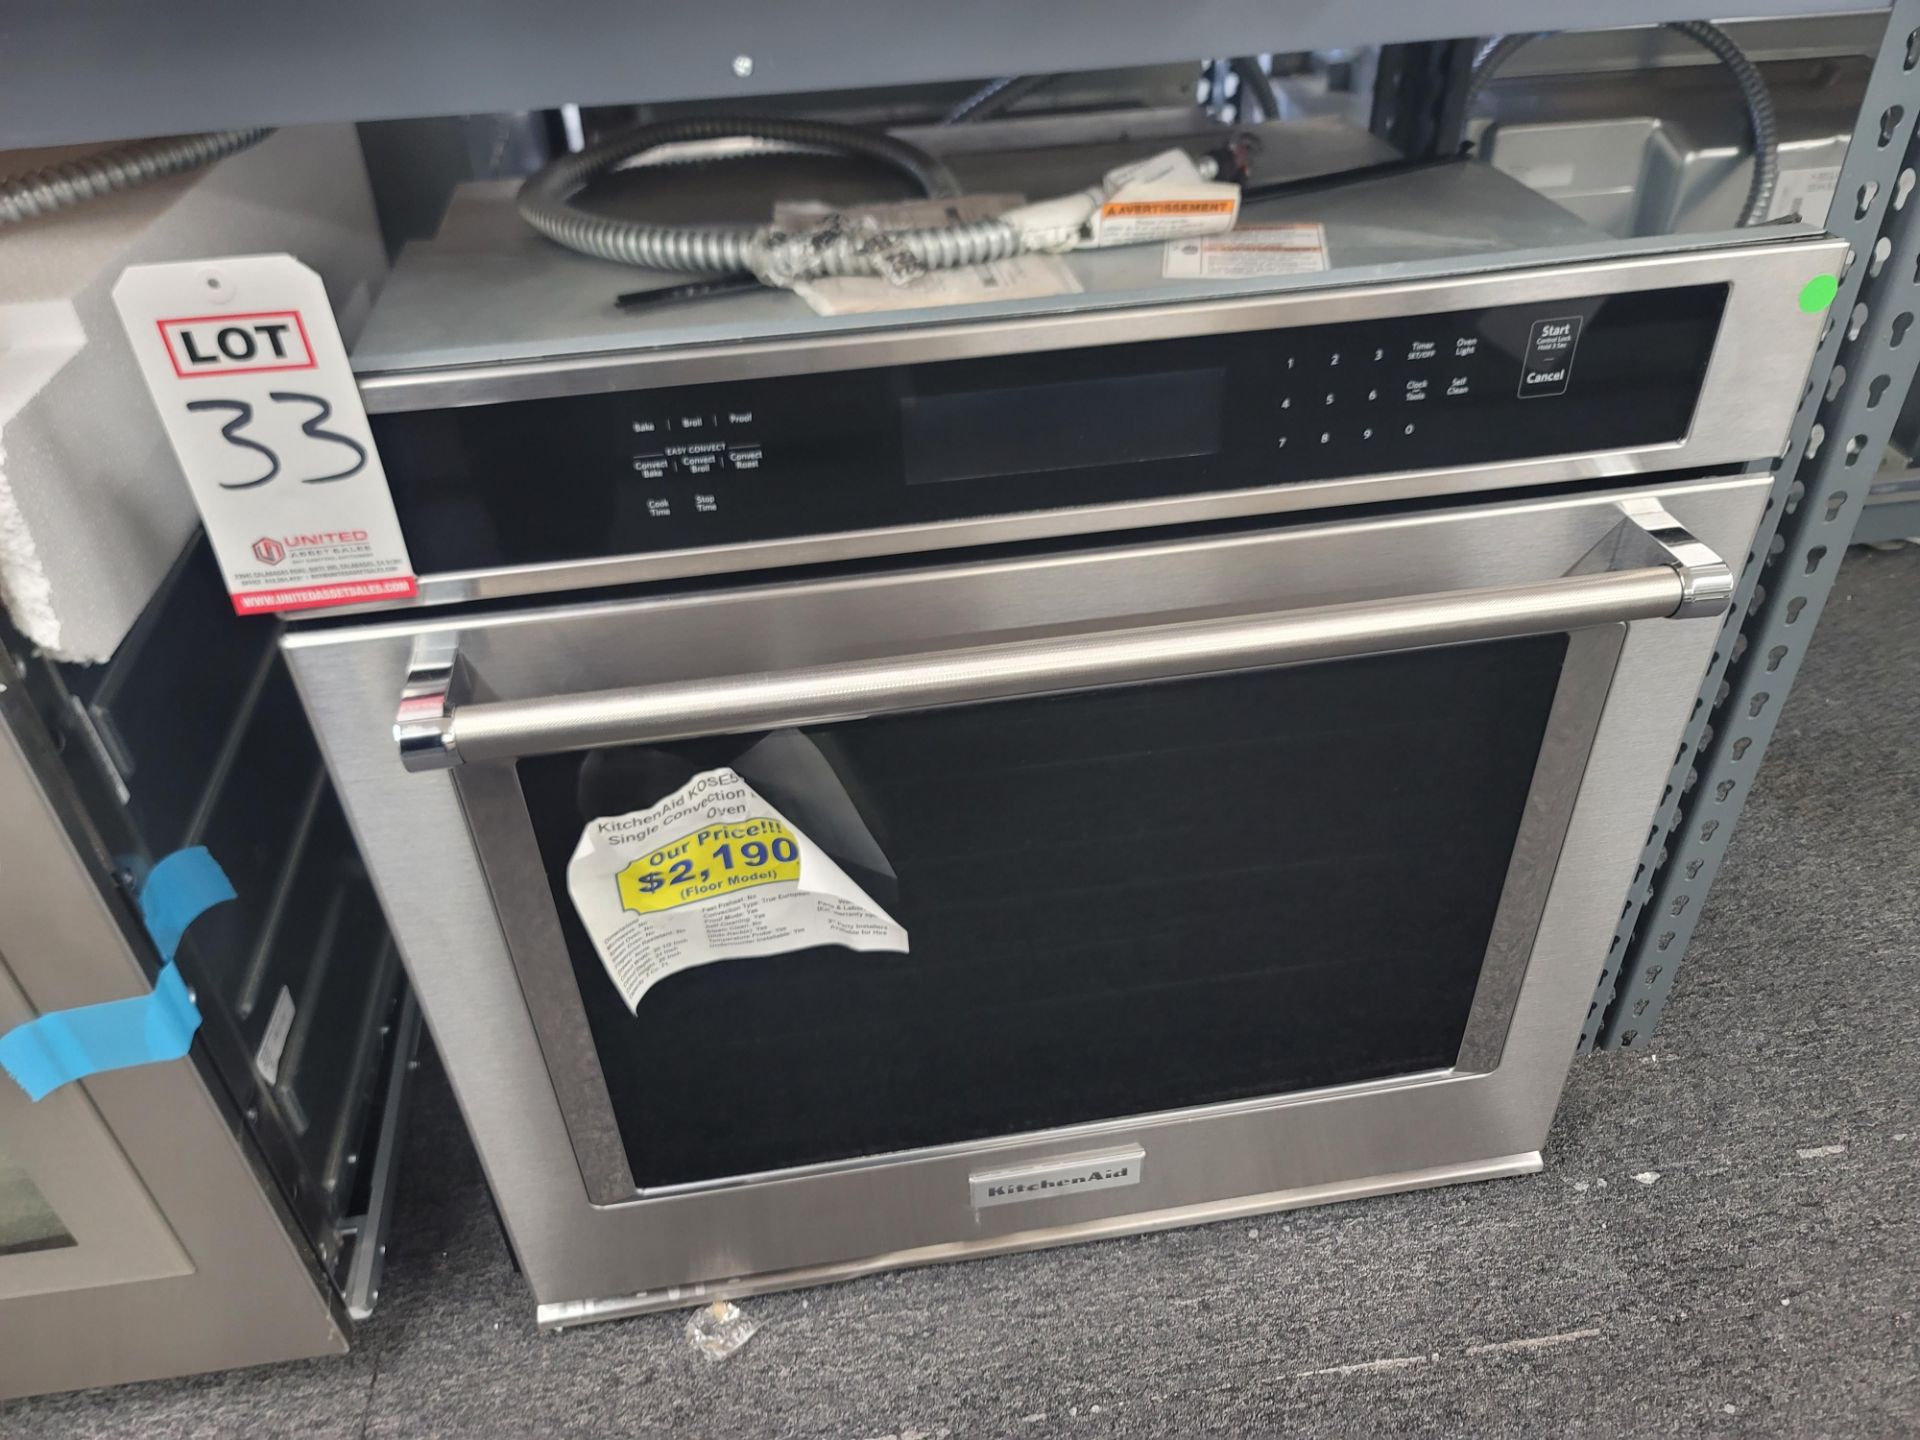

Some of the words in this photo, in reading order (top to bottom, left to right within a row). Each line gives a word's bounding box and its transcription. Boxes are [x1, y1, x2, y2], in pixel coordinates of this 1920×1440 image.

[1119, 202, 1229, 215] AVERTISSEMENT
[1542, 324, 1570, 337] Start
[179, 324, 289, 366] LOT
[1412, 342, 1435, 350] Timer
[1456, 338, 1478, 347] Oven
[1374, 350, 1383, 361] 3
[1407, 350, 1436, 360] SET/OFF
[1455, 346, 1475, 356] Light
[1287, 358, 1294, 369] 1
[1331, 354, 1340, 365] 2
[1451, 377, 1468, 386] Self
[1526, 369, 1565, 384] Cancel
[1406, 380, 1428, 389] Clock
[1369, 390, 1378, 400] 6
[1447, 387, 1469, 395] Clean
[1281, 398, 1290, 409] 4
[1325, 394, 1334, 405] 5
[682, 417, 703, 428] Broil
[729, 412, 752, 423] Proof
[633, 422, 655, 432] Bake
[1404, 424, 1414, 435] 0
[1321, 433, 1329, 443] 8
[1363, 429, 1373, 440] 9
[186, 391, 368, 490] 33
[1278, 438, 1287, 448] 7
[666, 447, 687, 456] EASY
[688, 443, 726, 454] CONVECT
[682, 455, 716, 465] Convect
[729, 450, 762, 461] Convect
[634, 460, 668, 470] Convect
[690, 465, 710, 473] Broil
[736, 460, 759, 469] Roast
[642, 470, 663, 478] Bake
[648, 499, 669, 508] Cook
[695, 495, 715, 504] Stop
[697, 504, 717, 512] Time
[284, 530, 369, 547] UNITED
[242, 581, 411, 607] WWW.UNITEDASSETSALES.COM
[597, 794, 686, 833] KitchenAid
[608, 823, 659, 846] Single
[663, 788, 746, 827] Convection
[706, 804, 747, 819] Oven
[650, 841, 690, 866] Our
[697, 820, 782, 846] Price!!!
[638, 837, 800, 894] $2,190
[680, 881, 724, 900] (Floor
[727, 870, 777, 886] Model)
[988, 1168, 1128, 1197] KitchenAid
